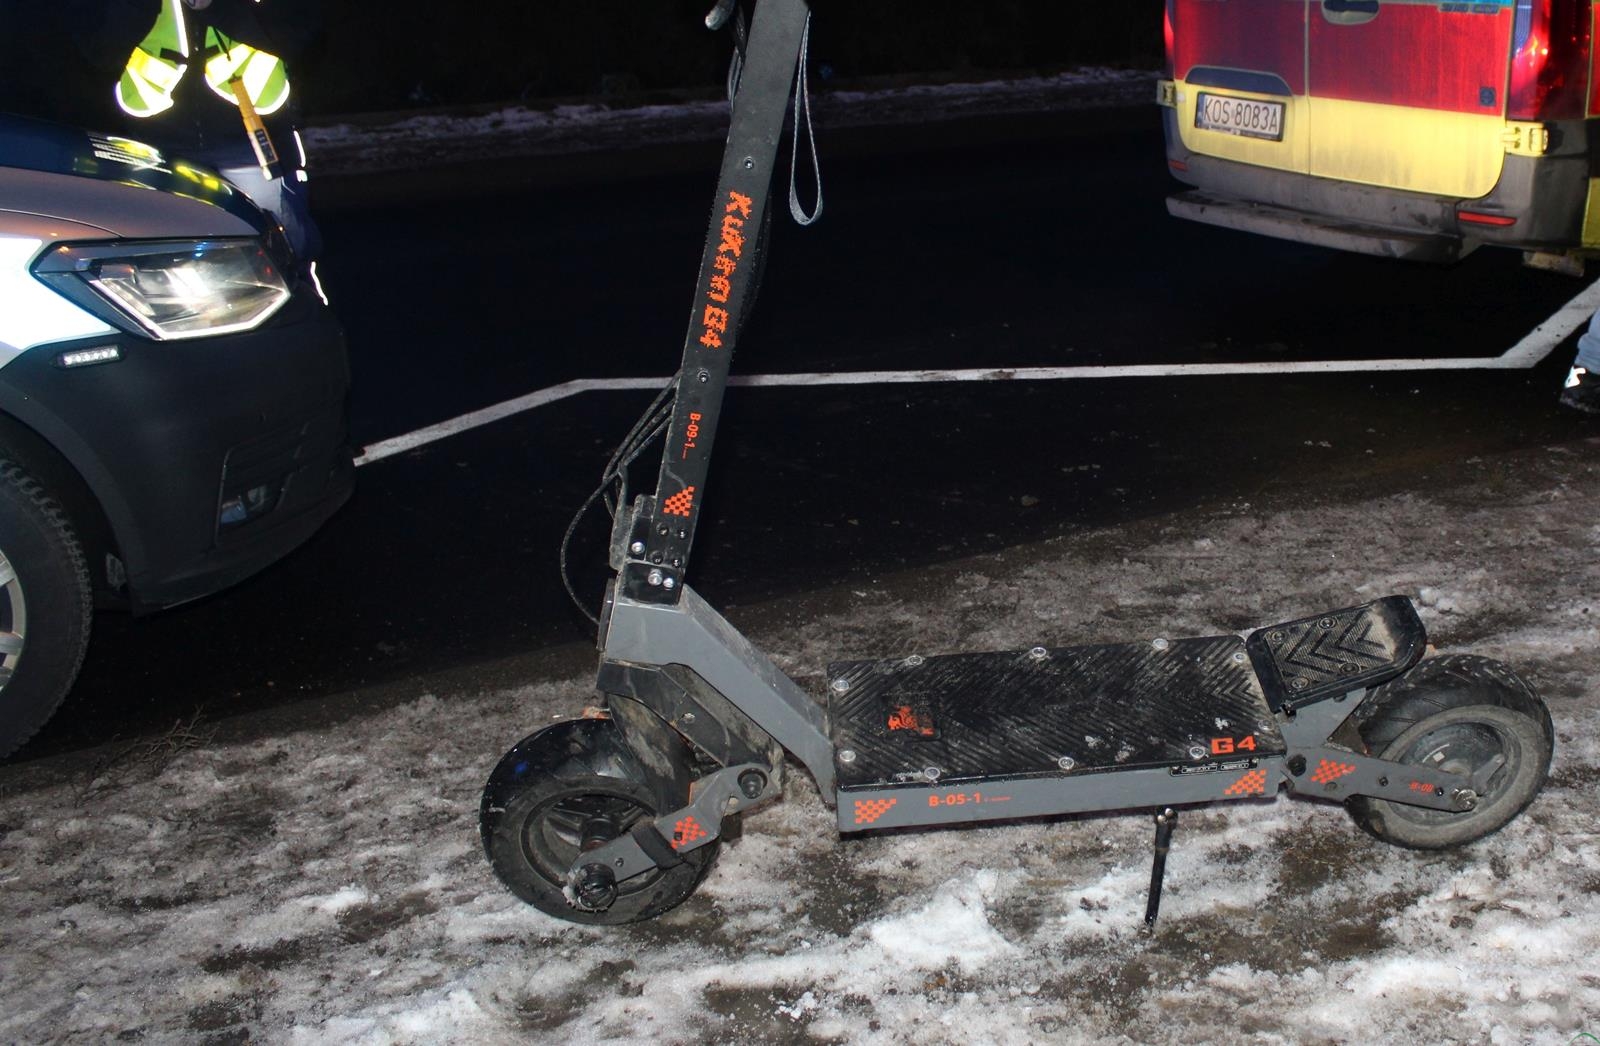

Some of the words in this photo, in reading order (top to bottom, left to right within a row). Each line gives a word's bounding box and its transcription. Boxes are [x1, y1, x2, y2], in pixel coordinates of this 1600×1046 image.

[1204, 97, 1230, 123] KOS
[1234, 102, 1277, 131] 8083A
[684, 412, 702, 448] B-09-1
[1211, 735, 1256, 755] G4
[928, 792, 982, 807] B-05-1
